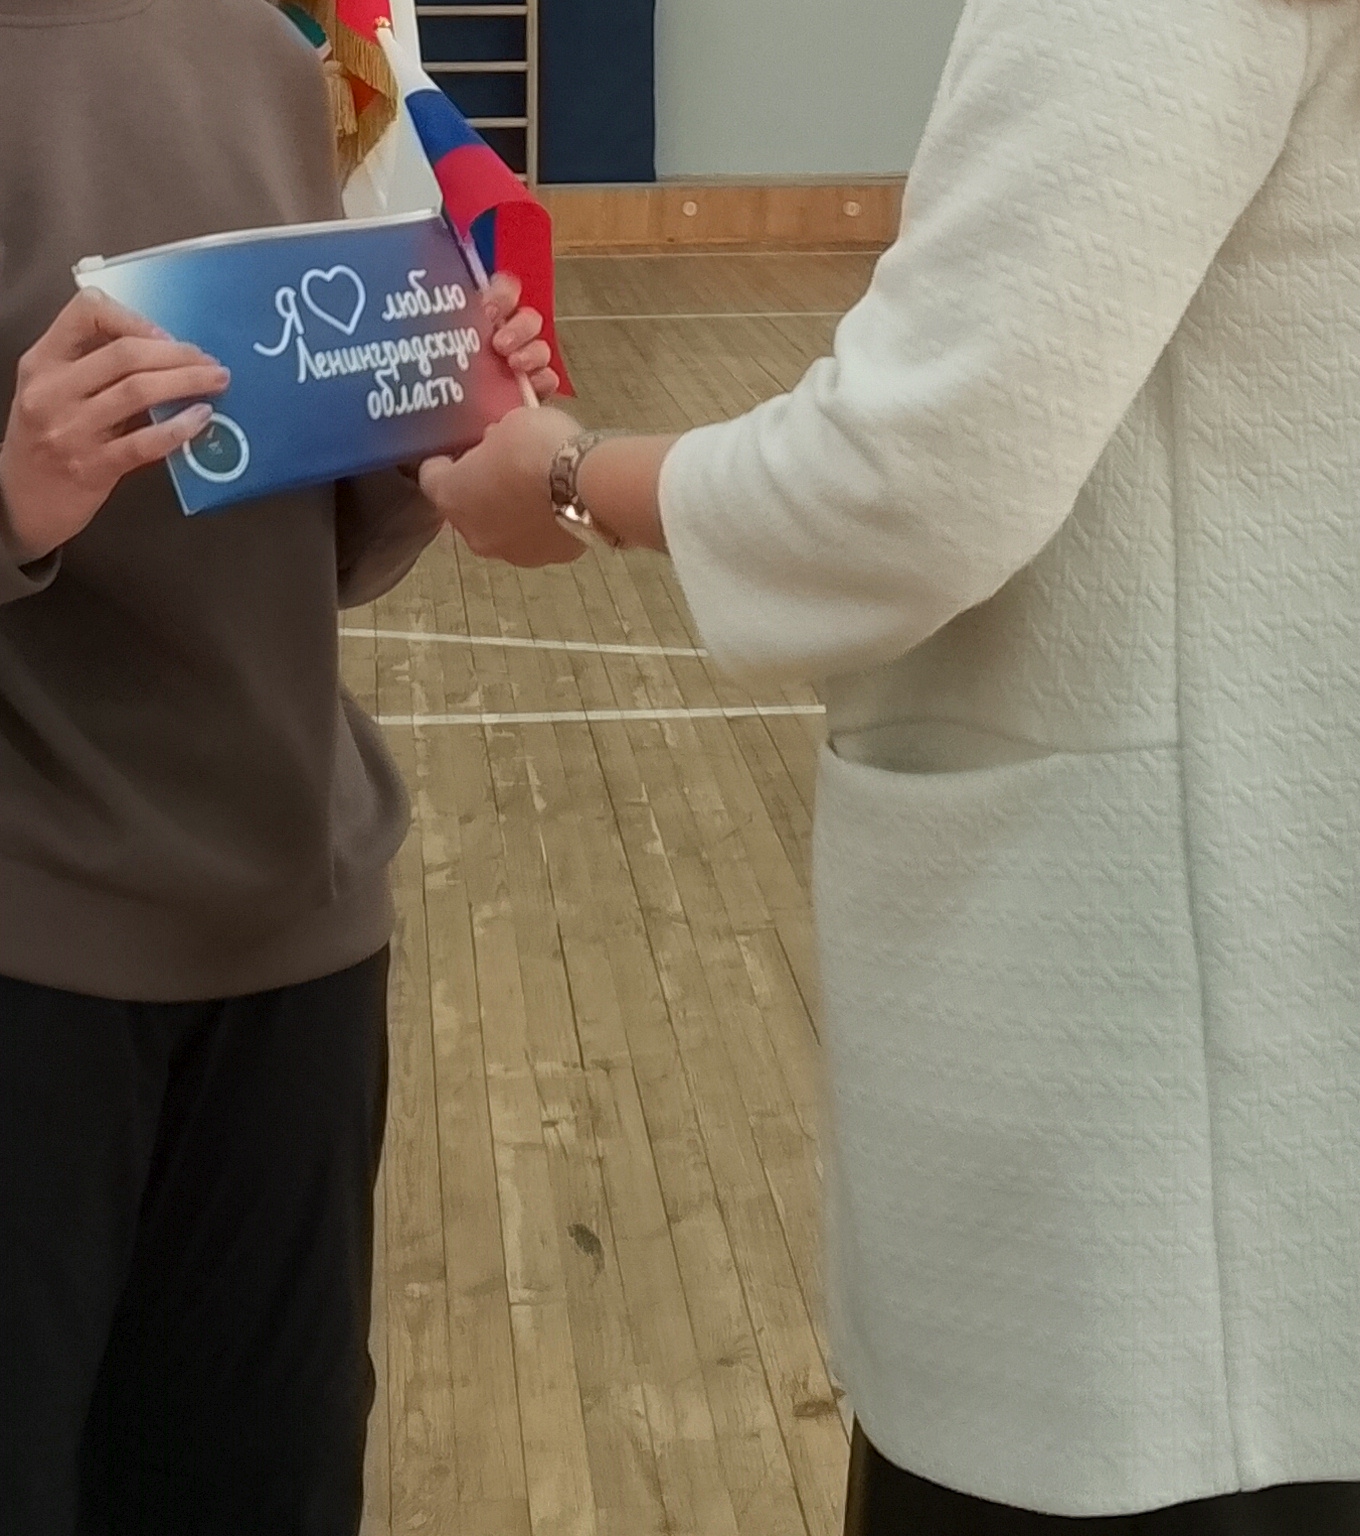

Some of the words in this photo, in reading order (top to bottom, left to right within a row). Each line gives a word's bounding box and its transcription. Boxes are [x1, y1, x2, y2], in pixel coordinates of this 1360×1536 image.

[253, 286, 304, 356] Я
[382, 269, 466, 321] люблю
[296, 327, 481, 383] Ленинградскую
[367, 368, 464, 420] область
